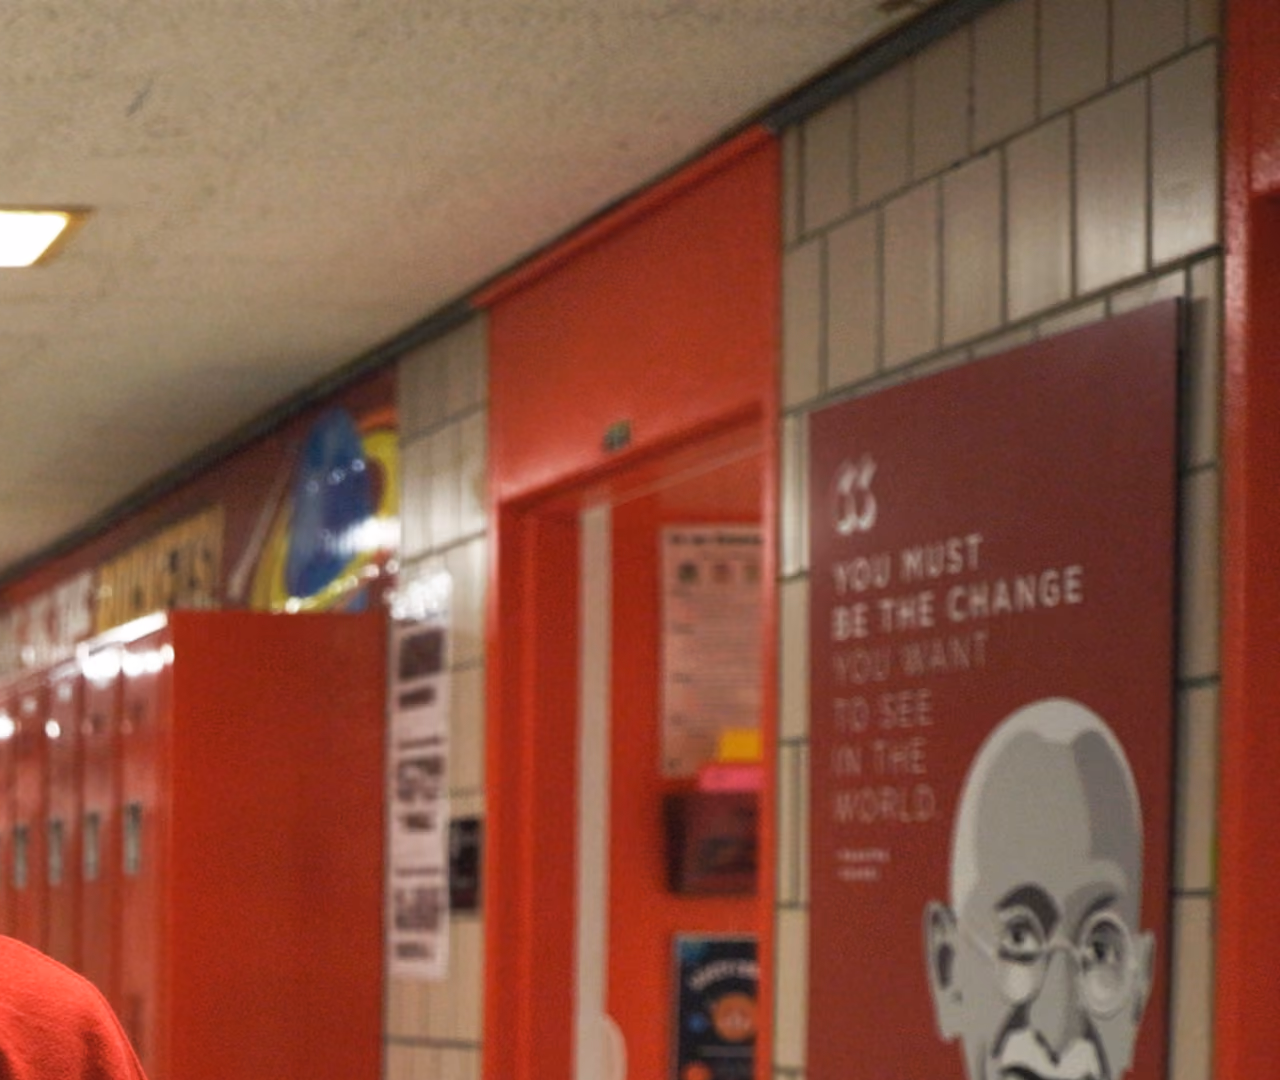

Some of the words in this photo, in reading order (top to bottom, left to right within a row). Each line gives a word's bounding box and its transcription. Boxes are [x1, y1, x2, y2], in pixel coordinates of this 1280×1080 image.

[832, 554, 891, 596] YOU
[900, 532, 984, 582] MUST
[831, 602, 870, 641] BE
[879, 589, 936, 633] THE
[946, 564, 1085, 624] CHANGE
[832, 647, 891, 686] YOU
[900, 629, 989, 678] WANT
